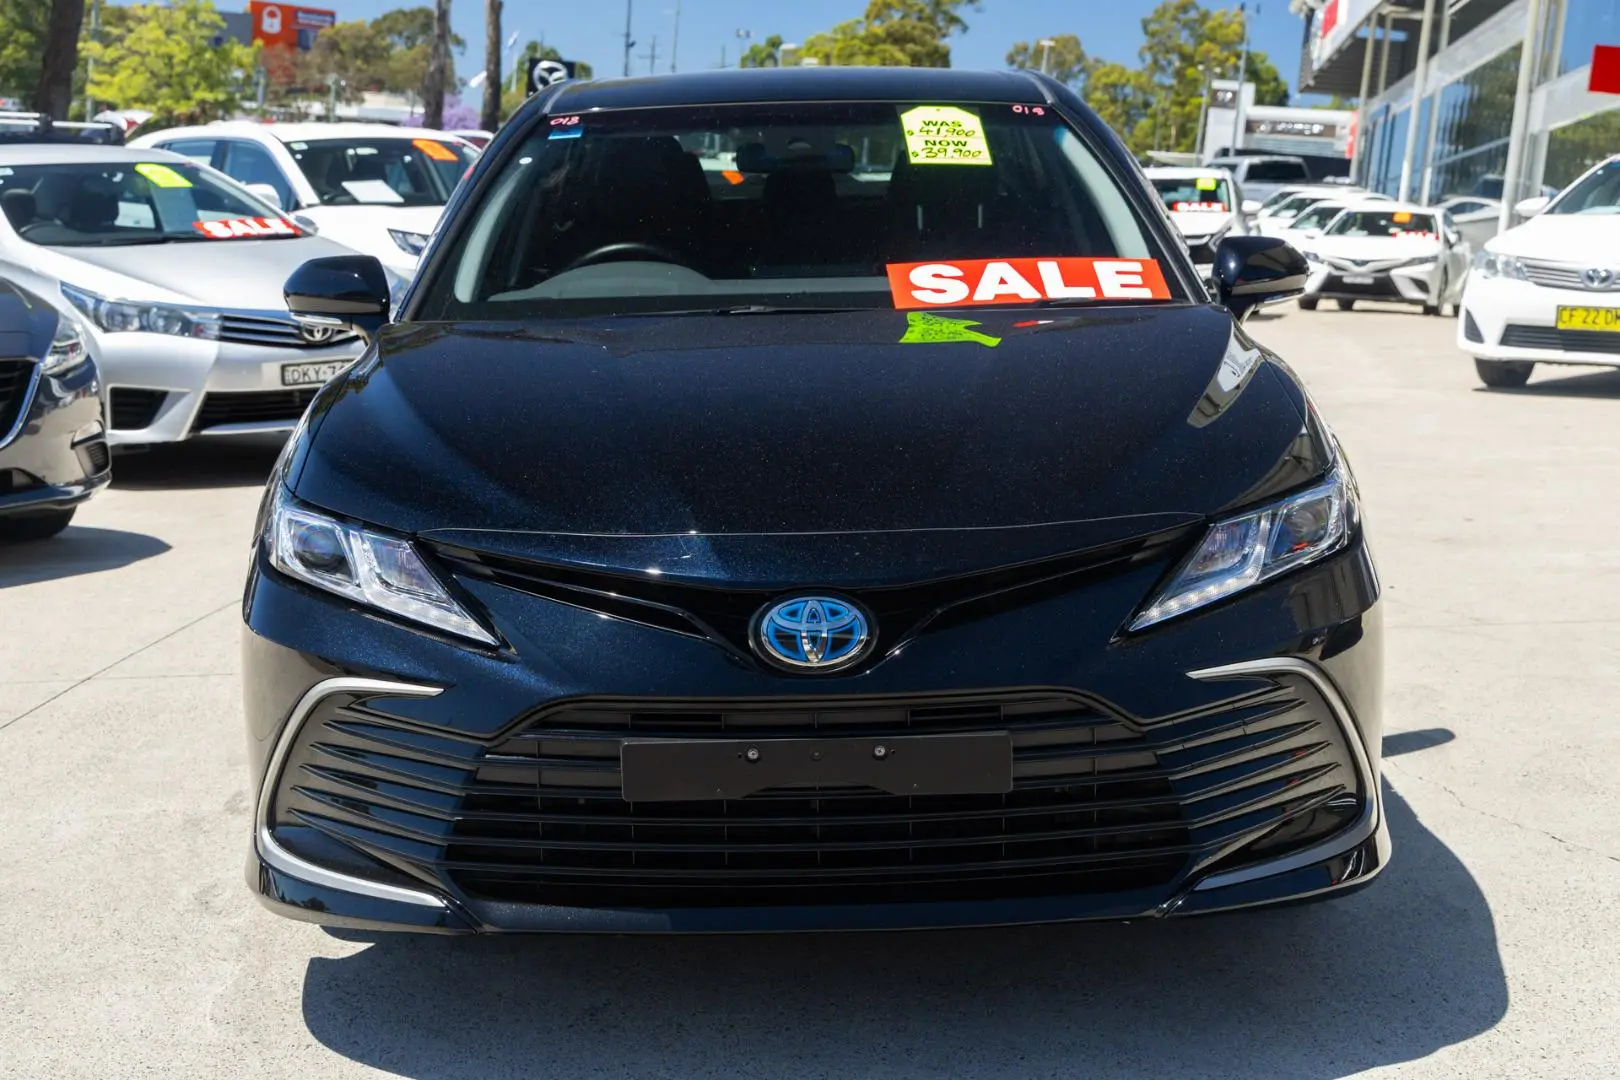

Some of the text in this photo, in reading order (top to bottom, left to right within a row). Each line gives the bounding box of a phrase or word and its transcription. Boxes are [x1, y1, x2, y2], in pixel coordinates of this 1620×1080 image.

[922, 120, 962, 128] WAS
[921, 147, 982, 158] 39,900
[203, 219, 296, 238] SALE
[908, 260, 1153, 304] SALE
